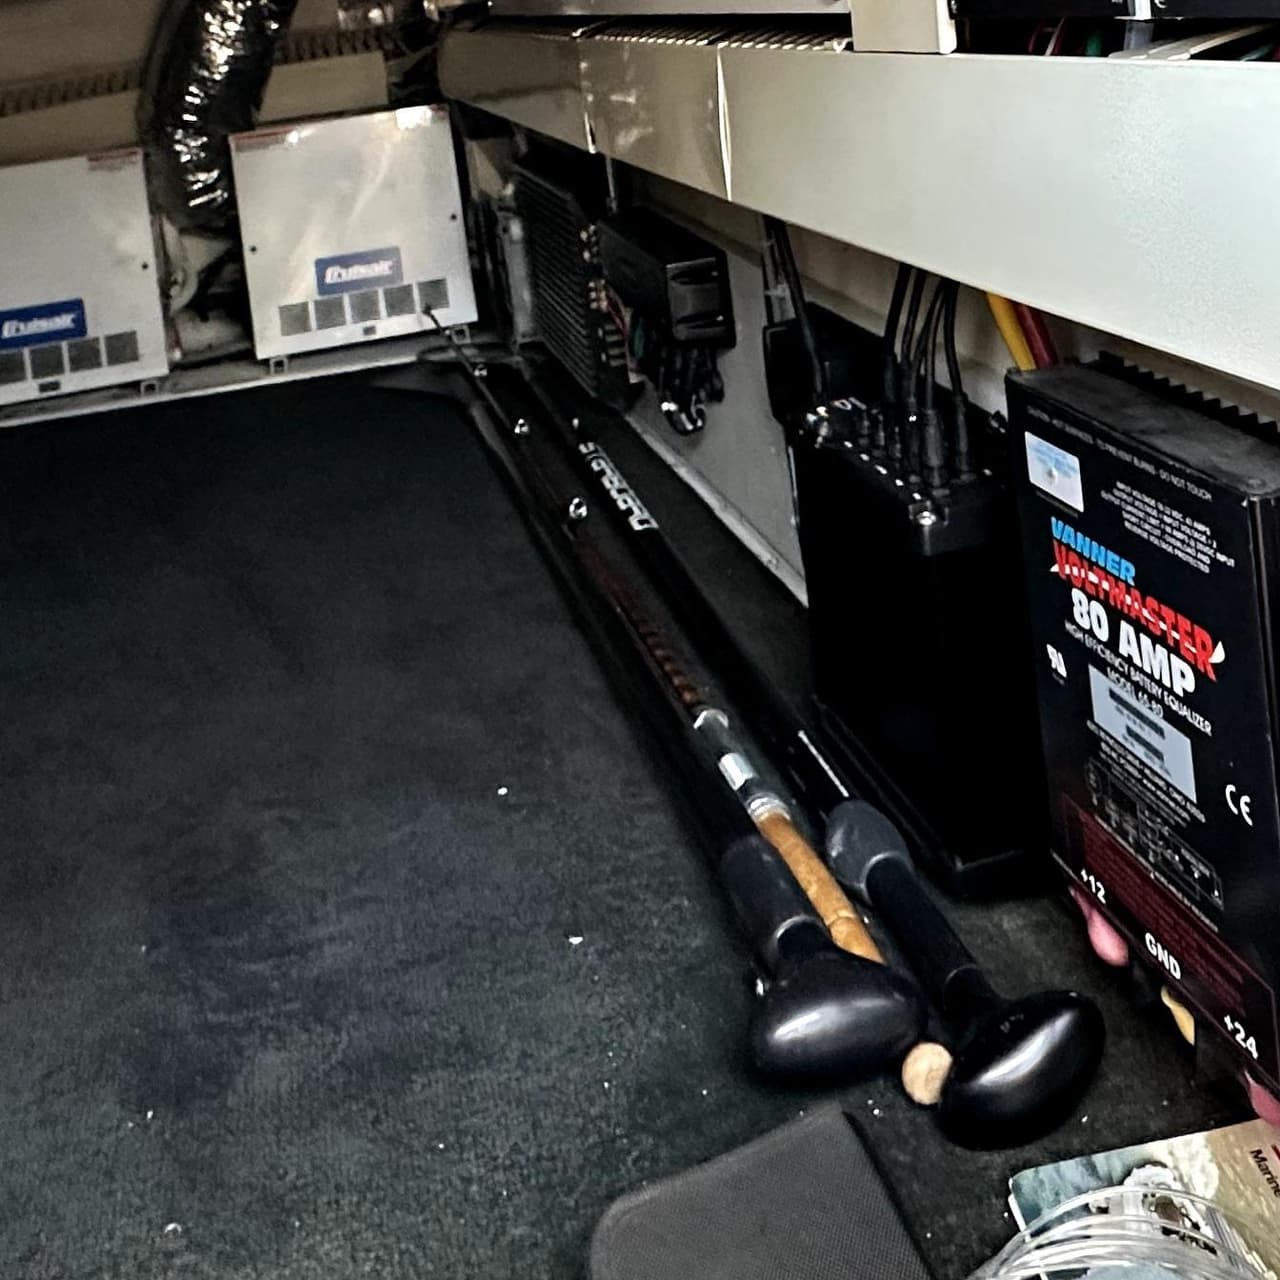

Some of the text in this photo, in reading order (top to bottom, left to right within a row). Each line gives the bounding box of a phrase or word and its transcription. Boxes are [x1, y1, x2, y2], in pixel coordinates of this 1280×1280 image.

[1051, 516, 1136, 586] VANNER
[1052, 539, 1217, 682] VOLTMASTER
[1071, 588, 1109, 643] 80
[1120, 620, 1196, 698] AMP
[1065, 620, 1085, 644] HIGH
[1086, 631, 1129, 677] EFFICIENCY
[1130, 662, 1163, 699] BATTERY
[1165, 685, 1213, 737] EQUALIZER
[1107, 666, 1137, 700] MODEL
[1081, 868, 1106, 904] +12
[1145, 932, 1181, 980] GND
[1224, 1014, 1259, 1059] +24
